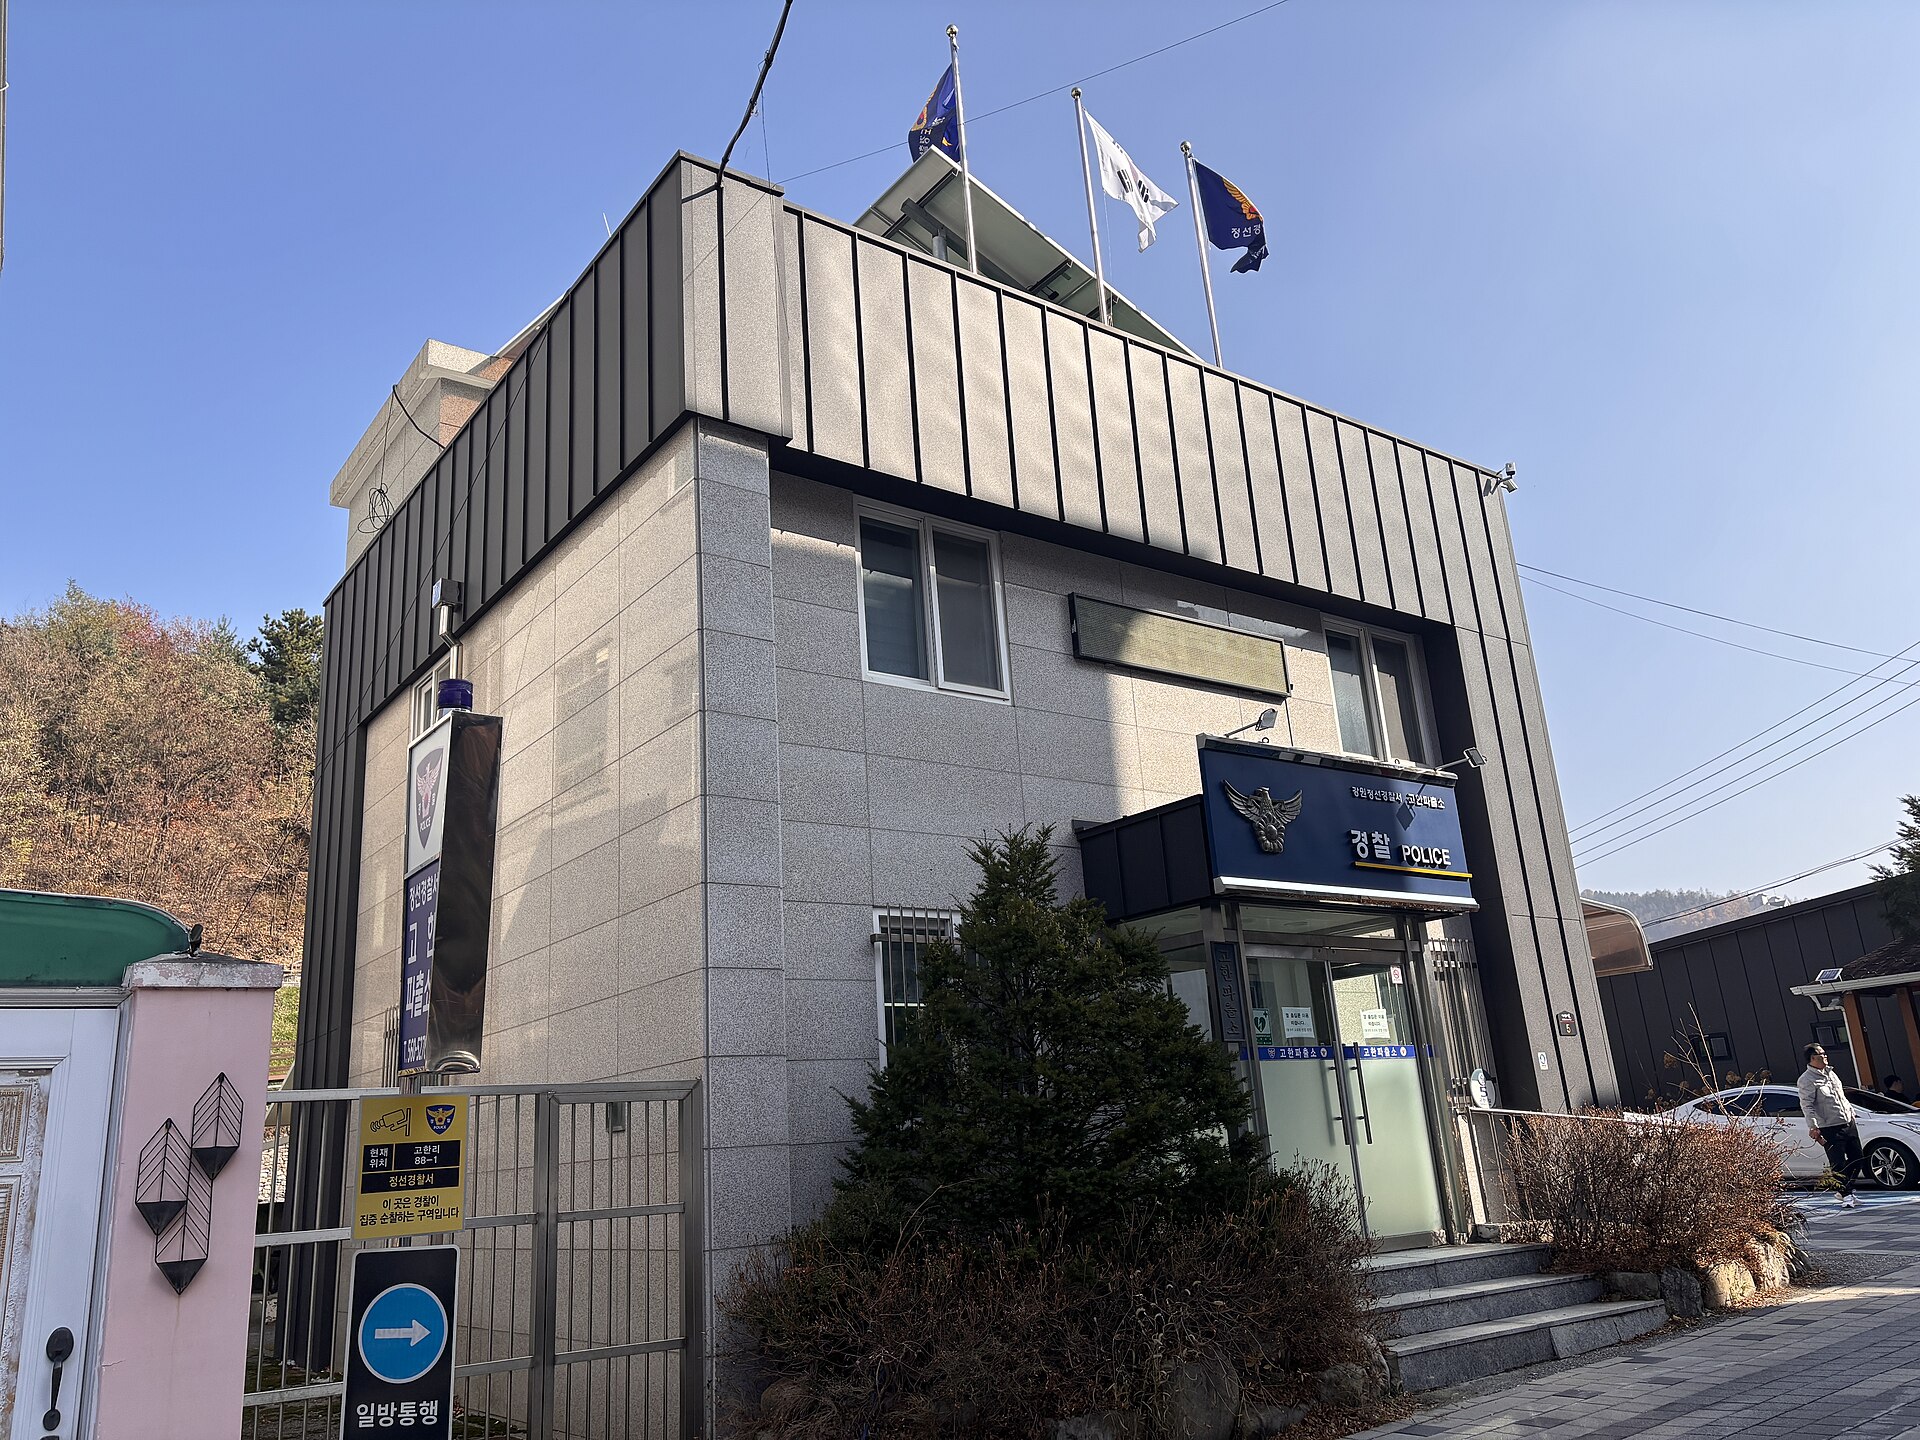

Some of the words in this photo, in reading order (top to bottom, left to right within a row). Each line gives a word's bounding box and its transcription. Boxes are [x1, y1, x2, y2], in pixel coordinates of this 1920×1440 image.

[1350, 829, 1391, 860] 경찰
[1401, 844, 1452, 866] POLICE
[1565, 1023, 1571, 1034] 5
[1279, 1048, 1317, 1058] 고한파출소
[1363, 1046, 1398, 1057] 고한파출소
[369, 1147, 389, 1158] 현재
[413, 1144, 440, 1155] 고한리
[369, 1157, 388, 1168] 위치
[414, 1155, 438, 1165] 88-1
[389, 1173, 434, 1188] 정선경찰서
[382, 1198, 391, 1210] 이
[393, 1197, 411, 1210] 곳은
[413, 1195, 439, 1208] 경찰이
[359, 1213, 377, 1226] 집중
[380, 1211, 415, 1224] 순찰하는
[417, 1206, 459, 1221] 구역입니다
[356, 1400, 439, 1428] 일방통행
